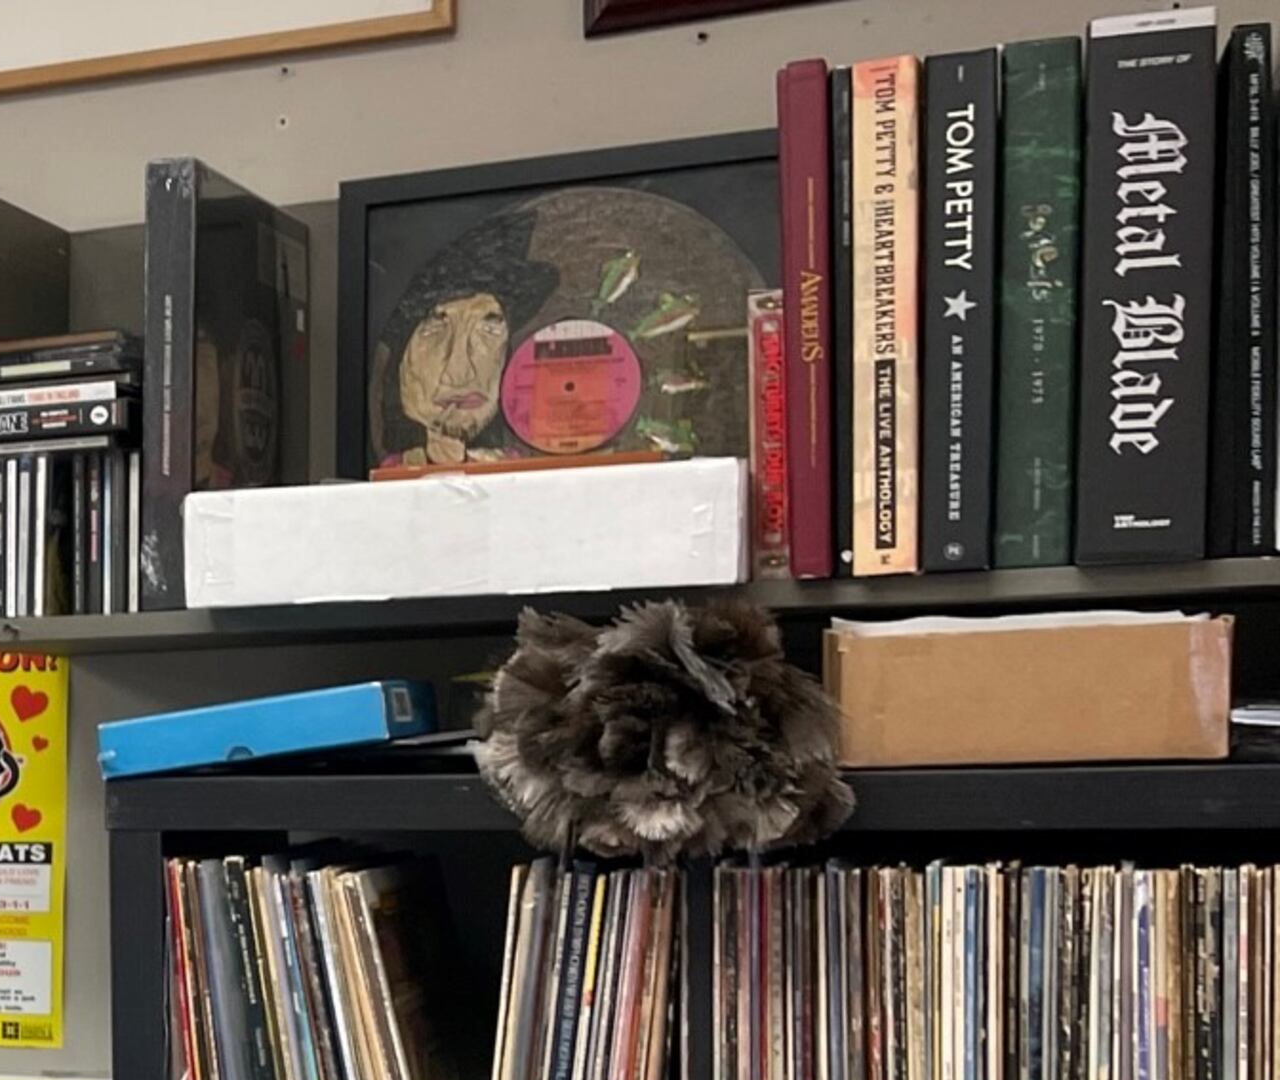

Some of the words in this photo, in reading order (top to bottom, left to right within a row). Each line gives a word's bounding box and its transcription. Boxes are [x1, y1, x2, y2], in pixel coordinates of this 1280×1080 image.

[874, 73, 896, 114] TOM
[874, 120, 896, 178] PETTY
[944, 103, 975, 173] TOM
[943, 181, 974, 272] PETTY
[1112, 111, 1189, 277] Metal
[798, 271, 824, 363] AMADEUS
[873, 205, 897, 357] HEARTBREAKERS
[878, 366, 892, 398] THE
[949, 334, 963, 354] AN
[1102, 293, 1187, 456] Blade
[878, 403, 892, 439] LIVE
[949, 360, 963, 438] AMERICAN
[878, 444, 892, 544] ANTHOLOGY
[948, 442, 962, 521] TREASURE
